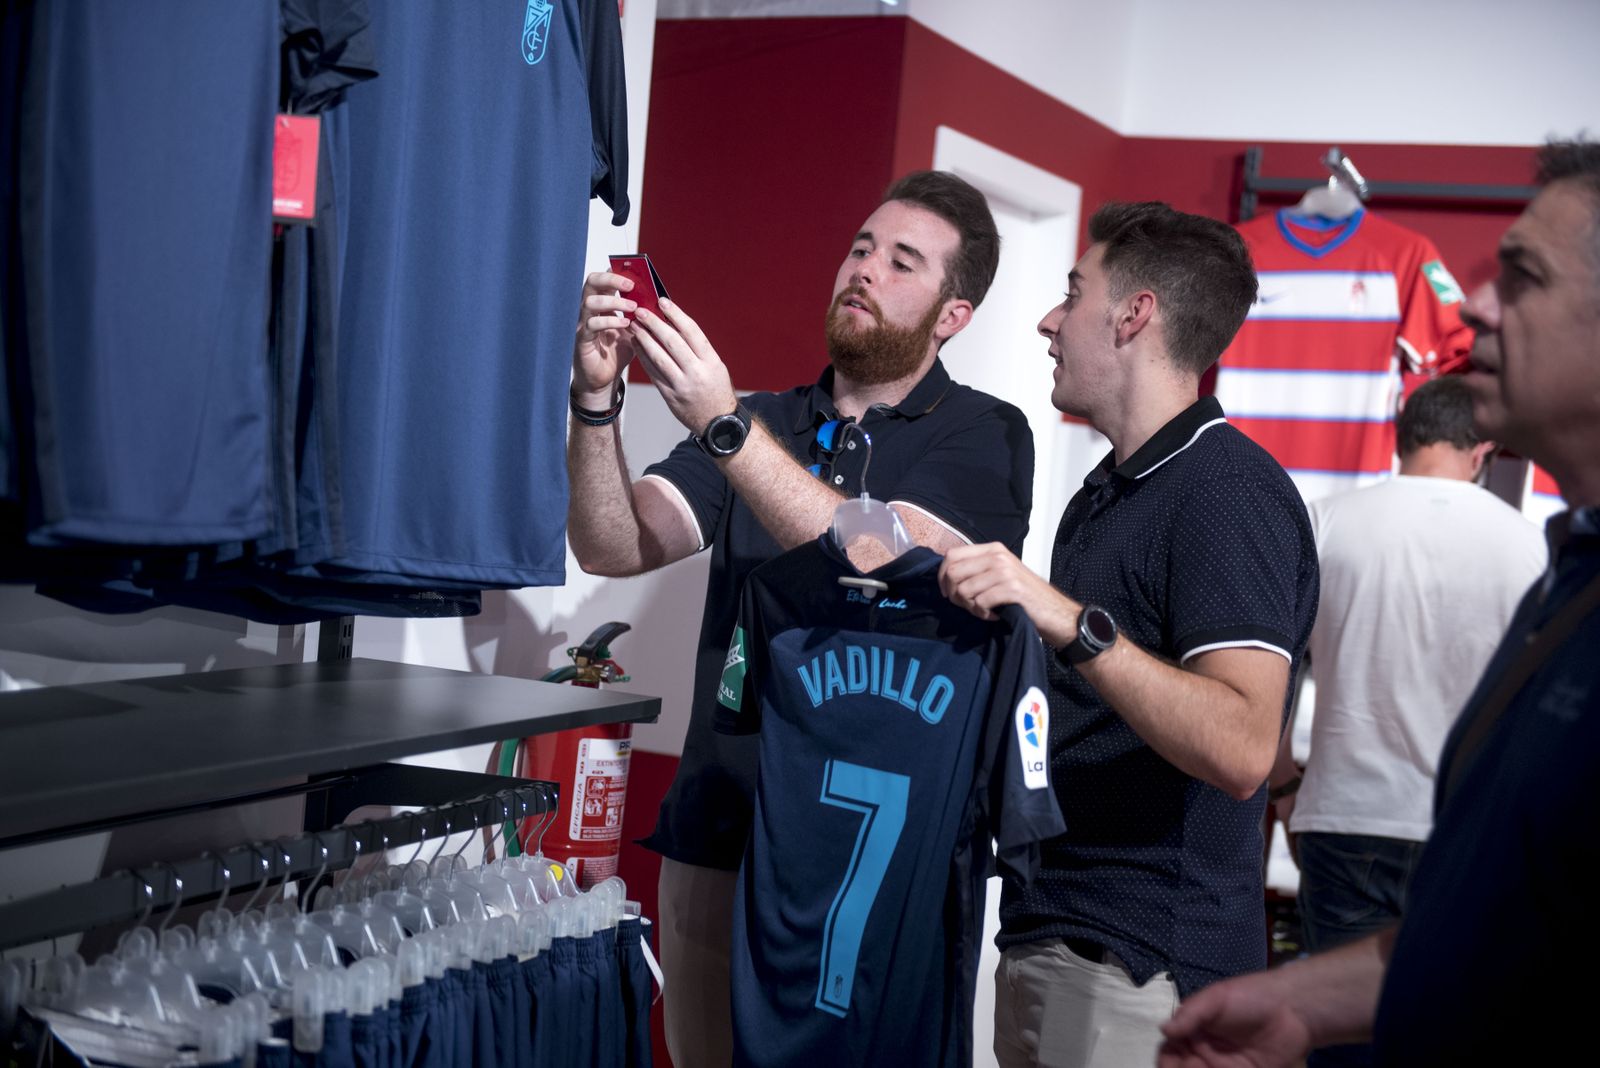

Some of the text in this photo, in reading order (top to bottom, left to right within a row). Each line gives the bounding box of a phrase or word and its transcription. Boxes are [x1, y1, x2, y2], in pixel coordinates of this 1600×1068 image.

[797, 645, 955, 725] VADILLO
[1027, 760, 1043, 772] La
[573, 783, 583, 834] EFICACIA
[815, 758, 911, 1018] 7
